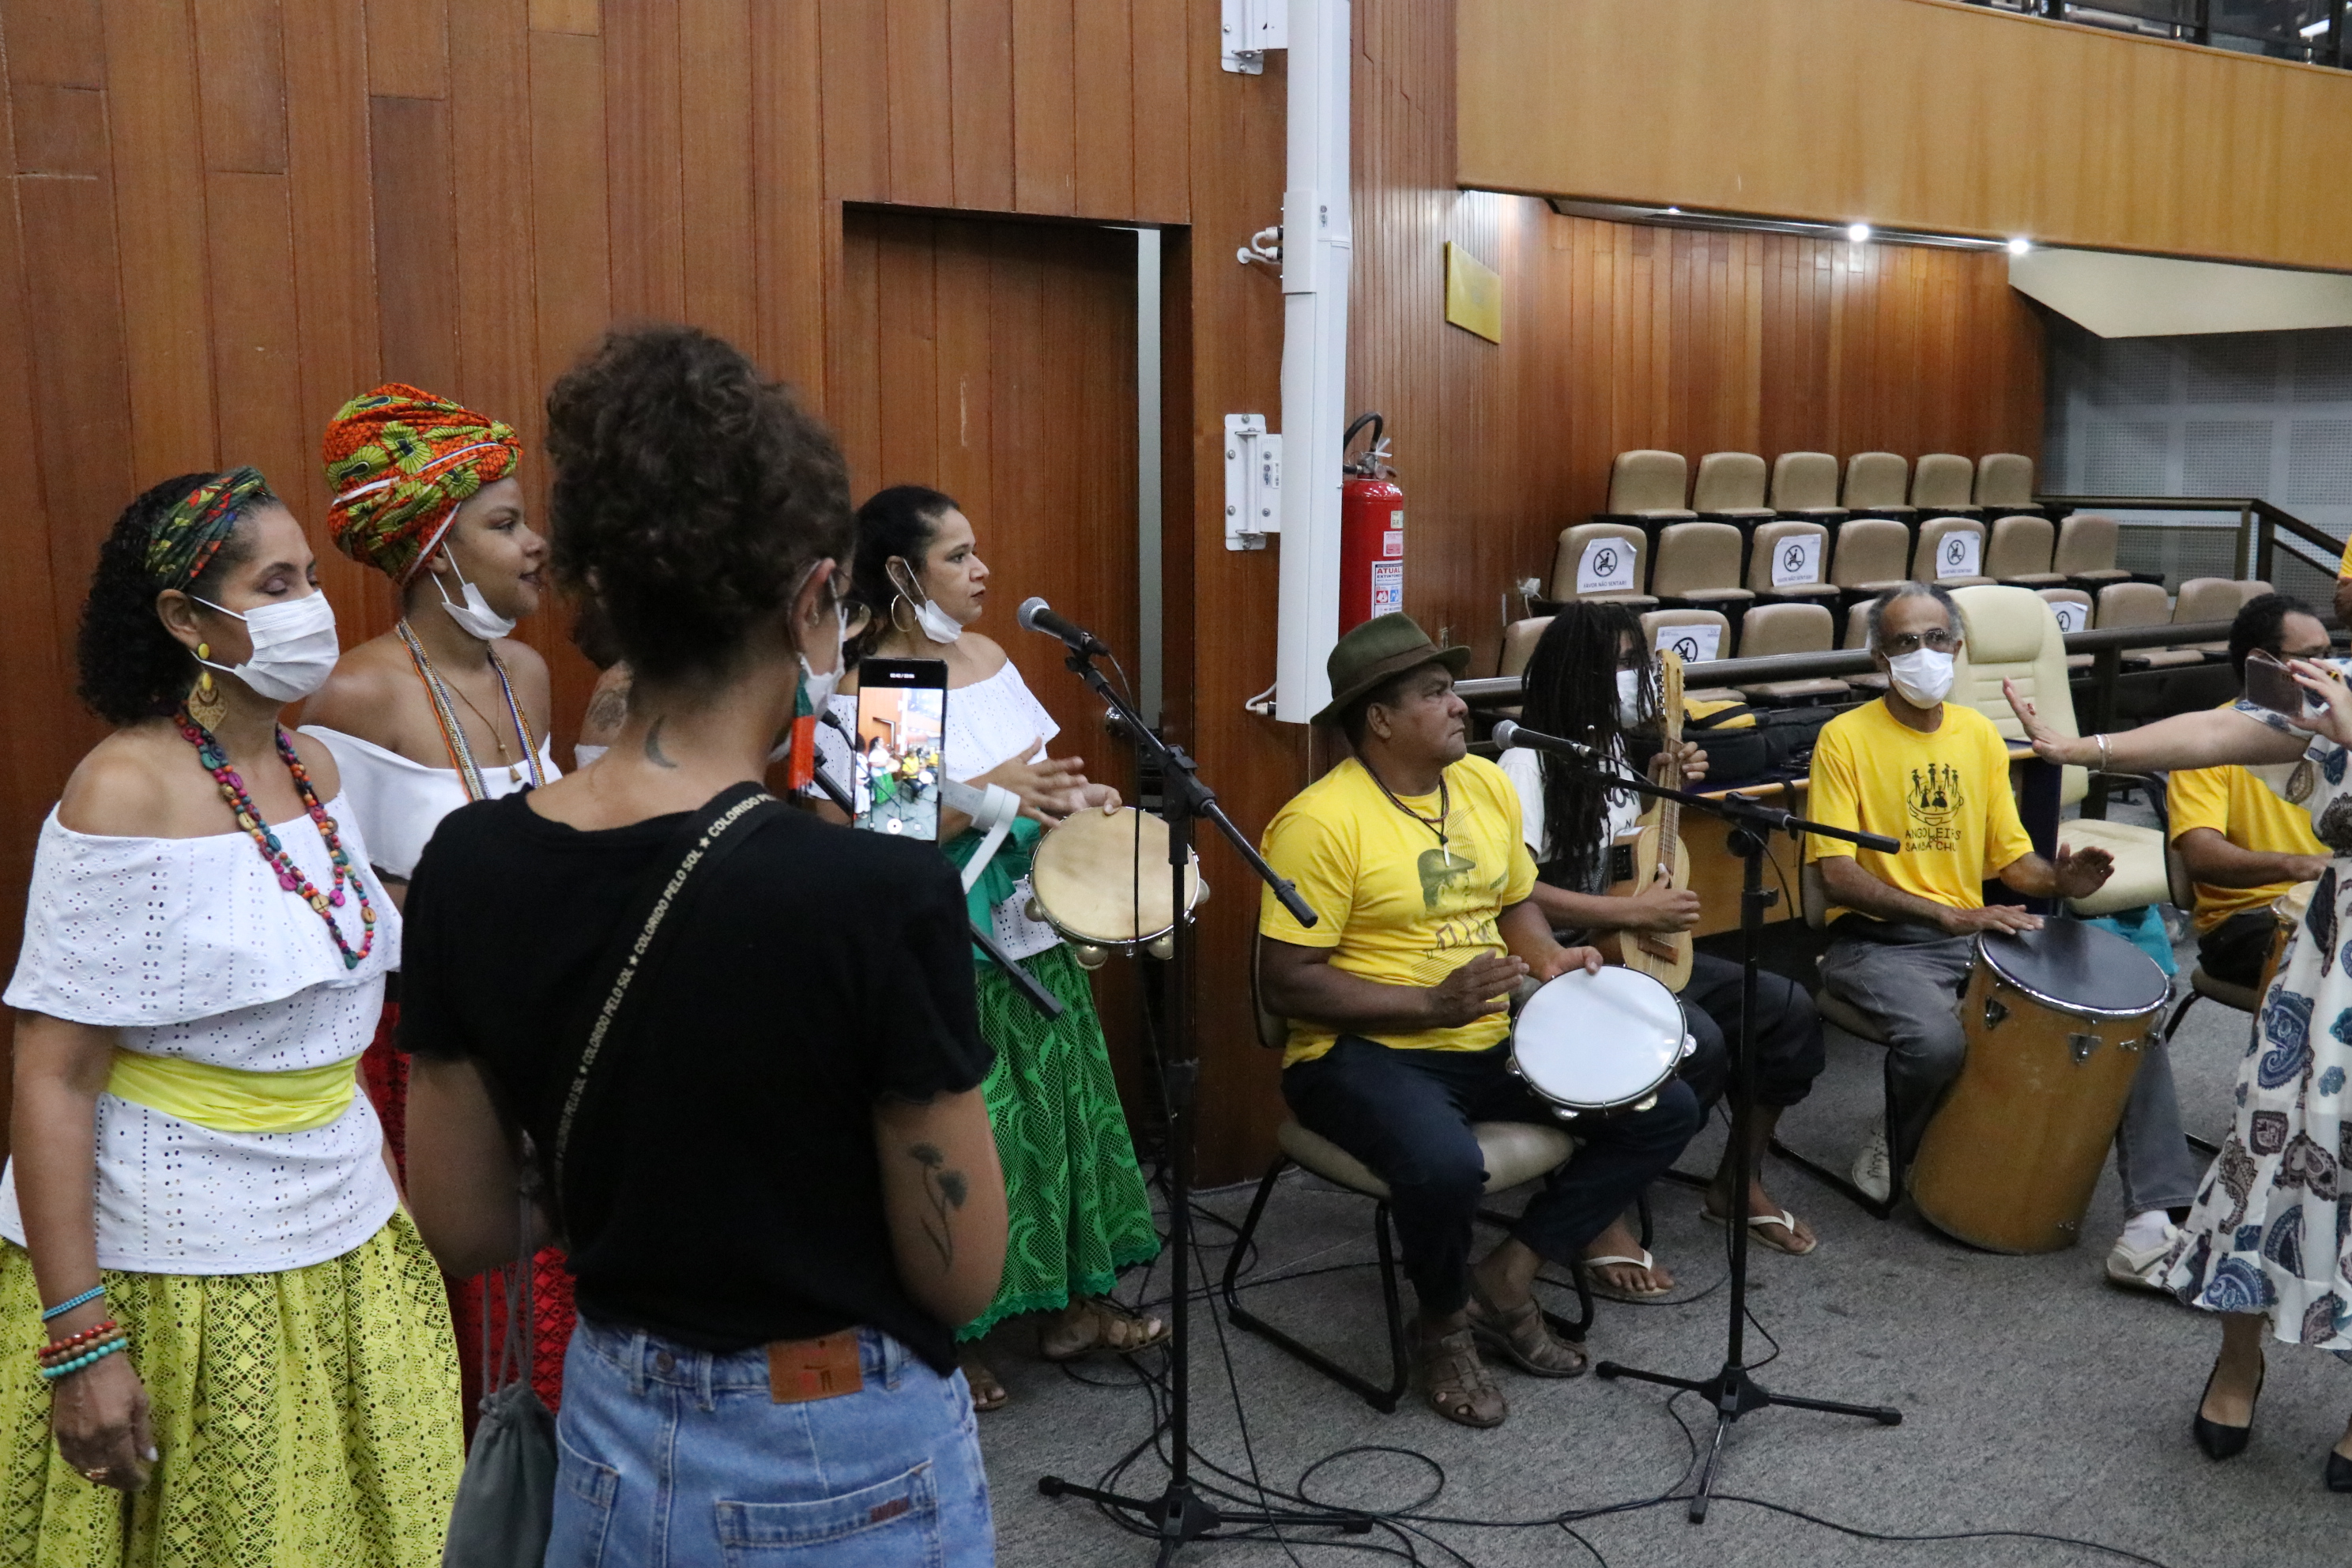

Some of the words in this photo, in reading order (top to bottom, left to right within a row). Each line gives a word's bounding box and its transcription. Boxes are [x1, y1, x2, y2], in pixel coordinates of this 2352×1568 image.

[707, 797, 760, 837] COLORIDO
[634, 898, 669, 955] COLORIDO
[663, 869, 687, 901] PELO
[681, 849, 704, 872] SOL
[582, 1015, 611, 1065] COLORIDO
[602, 986, 624, 1016] PELO
[616, 967, 635, 989] SOL
